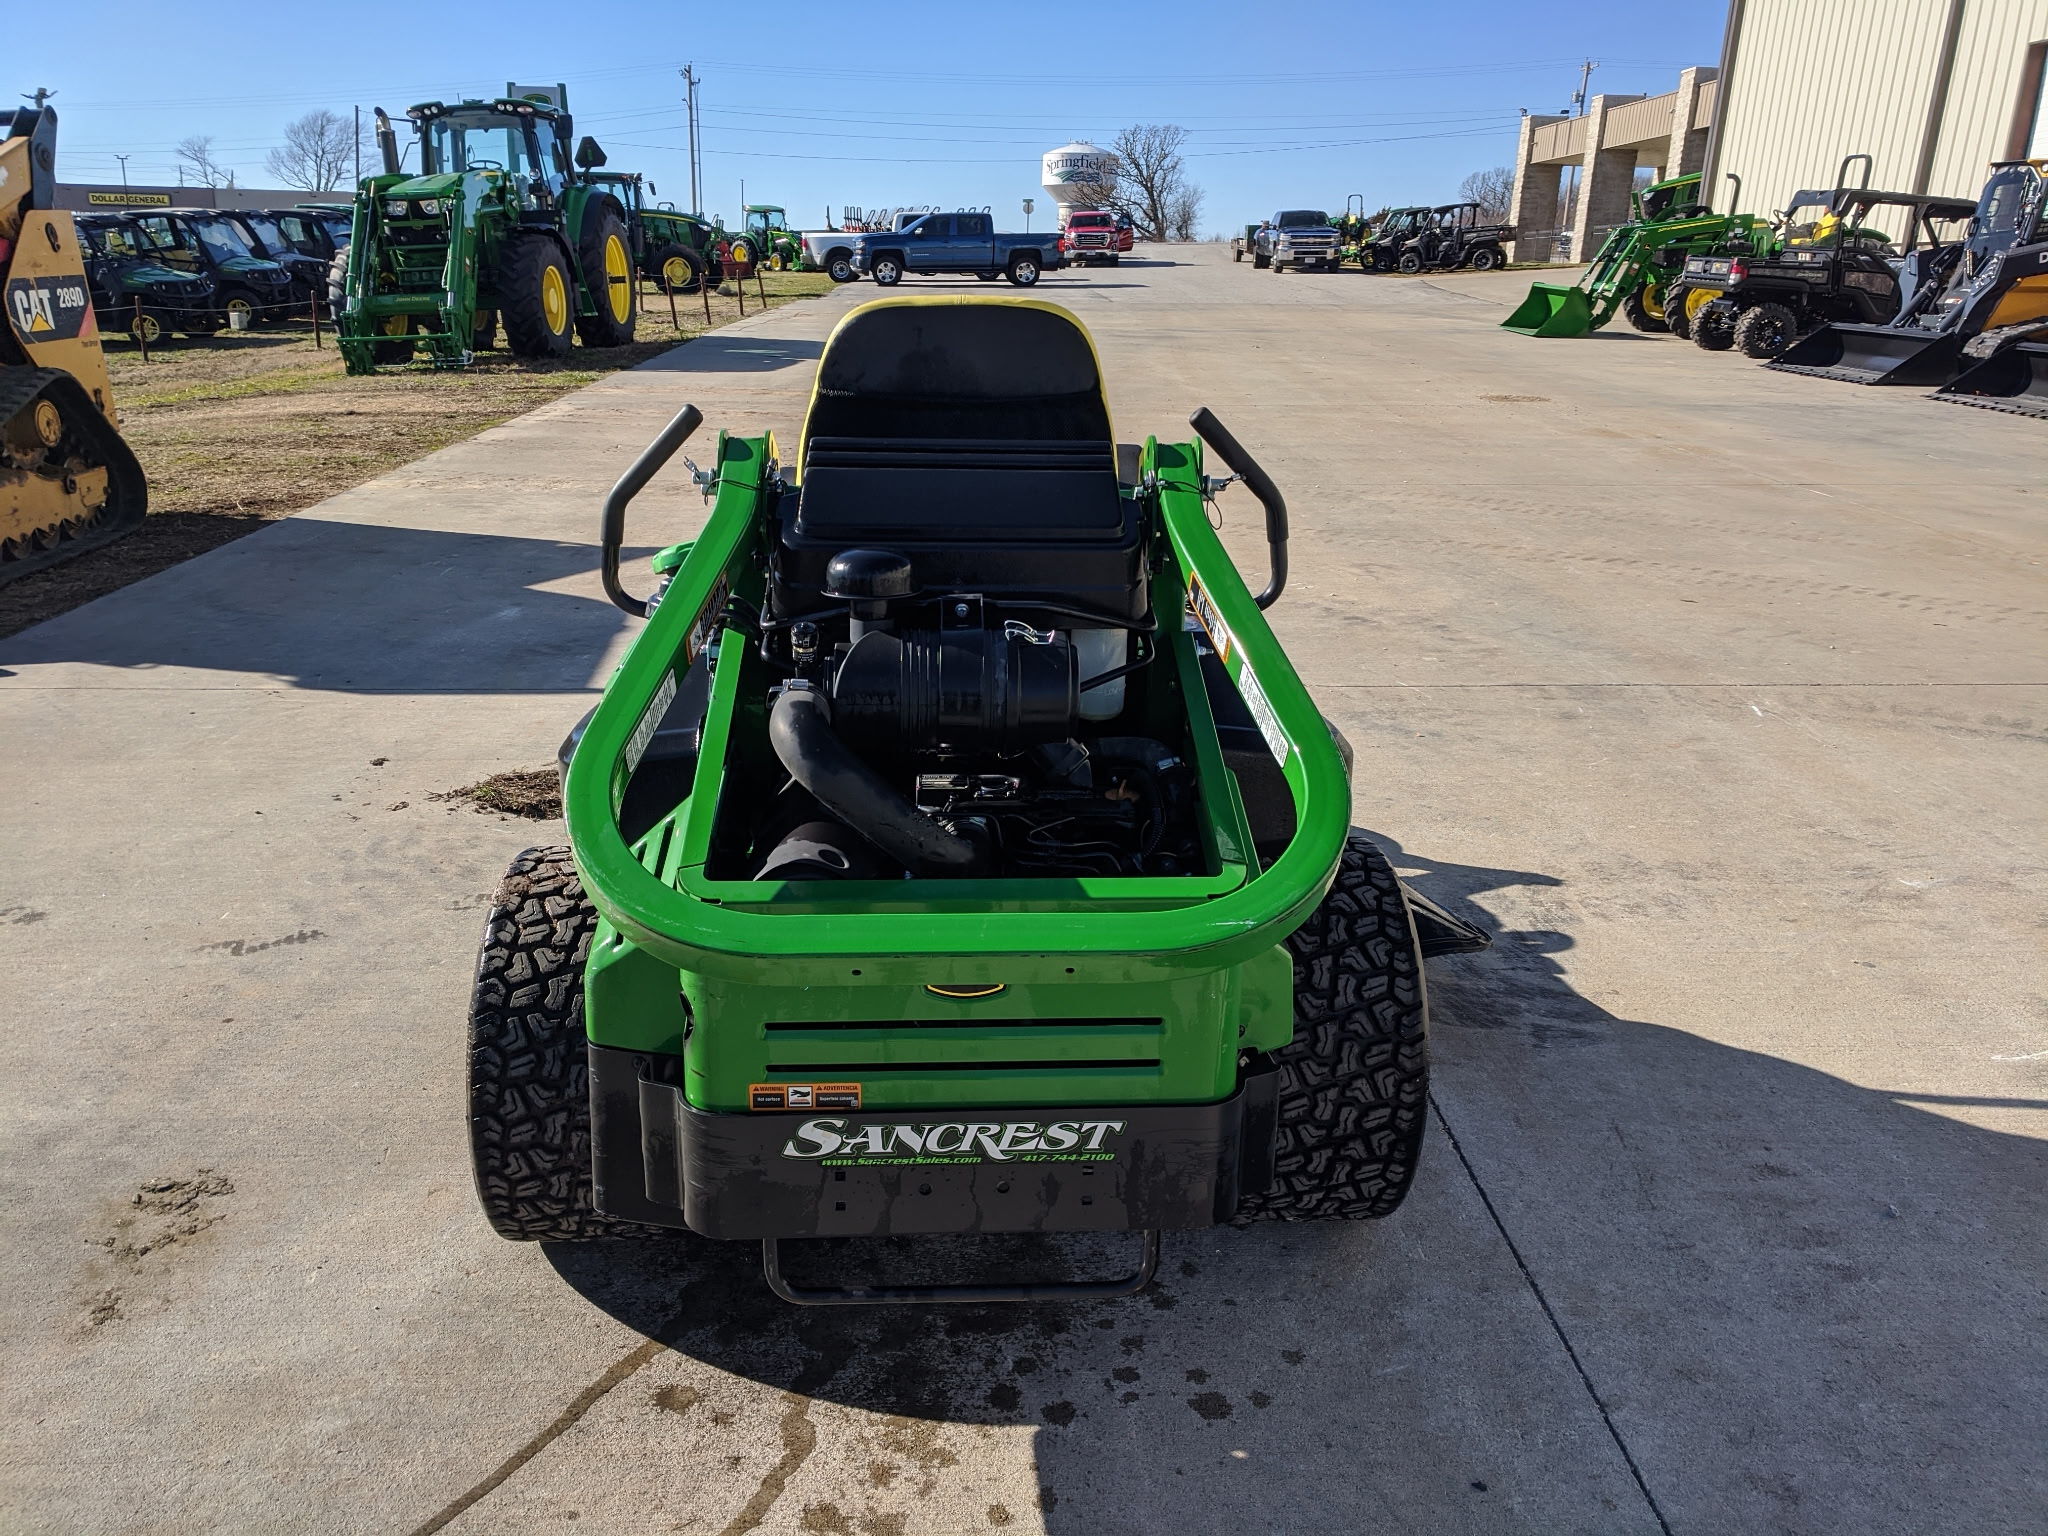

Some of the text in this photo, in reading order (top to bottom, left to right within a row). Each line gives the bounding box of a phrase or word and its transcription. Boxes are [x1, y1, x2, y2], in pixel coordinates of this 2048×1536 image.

[1046, 154, 1106, 174] Springfield
[91, 194, 167, 204] DOLLAR GENERAL
[13, 286, 85, 333] CAT 289D
[782, 1118, 1125, 1162] SANCREST
[821, 1156, 982, 1167] www.SancrestSales.com
[1021, 1153, 1116, 1163] 417-744-2100
